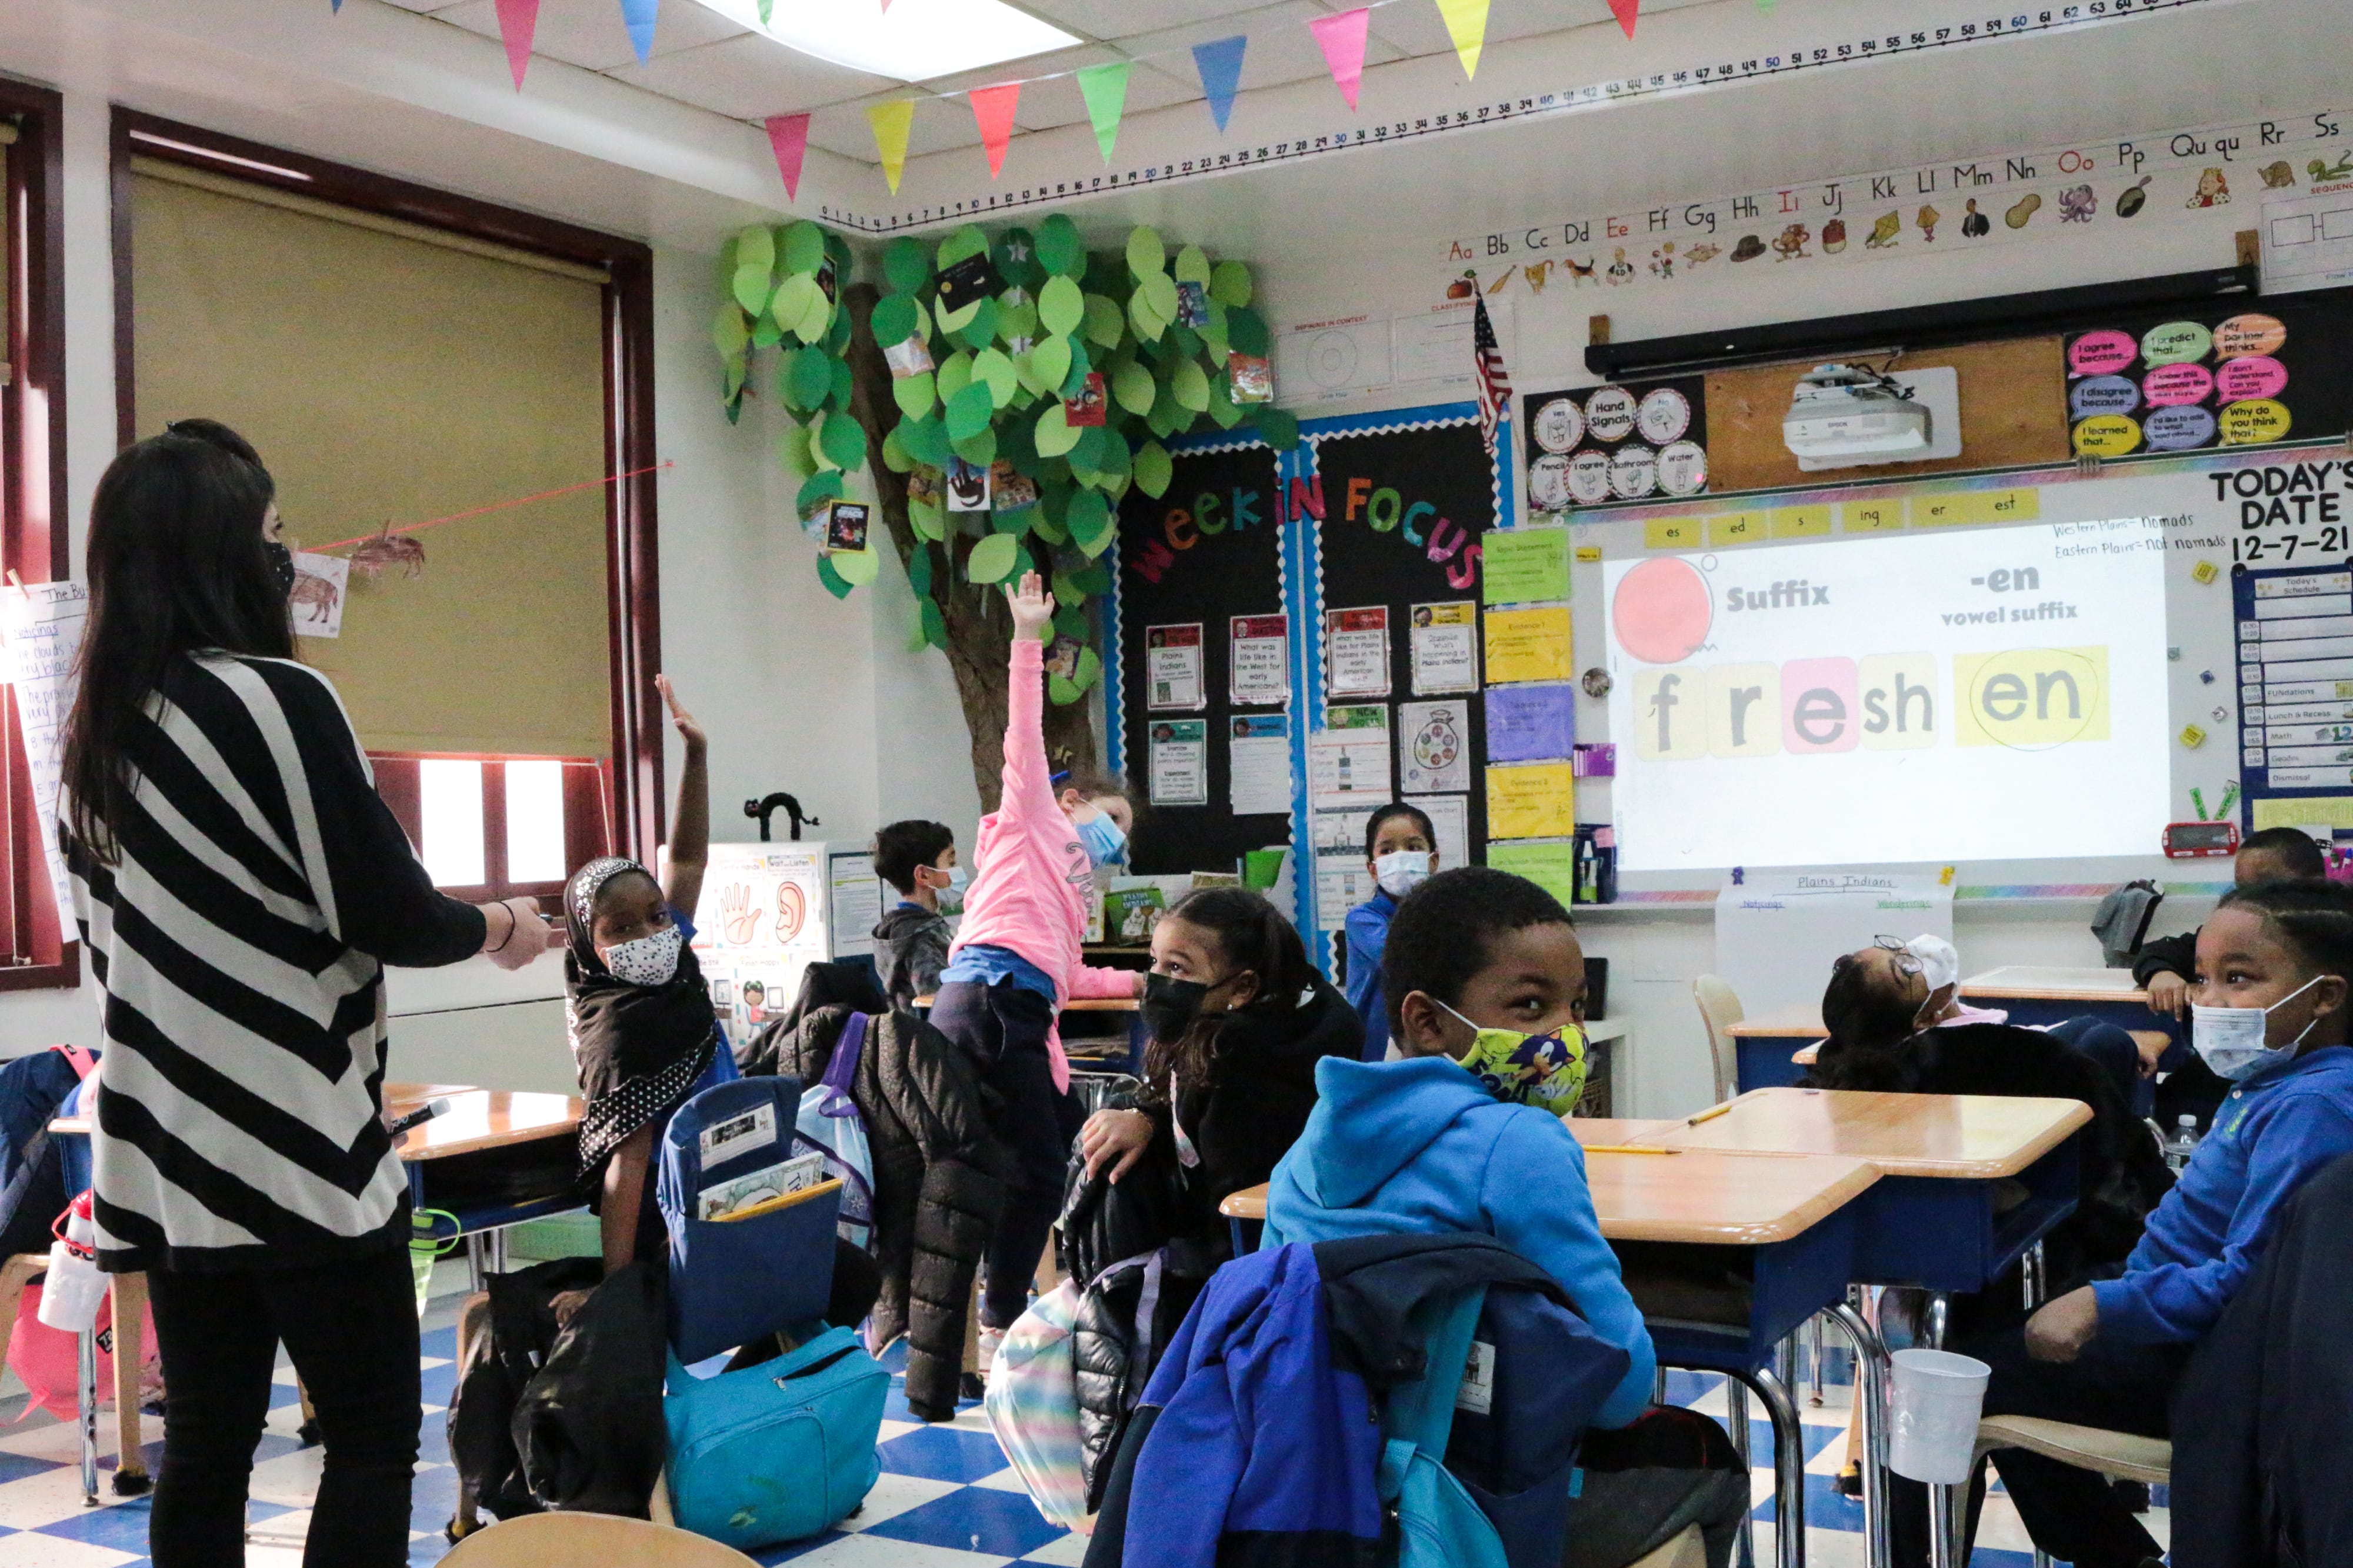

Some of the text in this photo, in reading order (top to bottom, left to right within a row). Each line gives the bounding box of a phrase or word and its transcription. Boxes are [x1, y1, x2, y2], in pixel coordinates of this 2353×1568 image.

[1200, 2, 2105, 168] 23 24 25 26 27 28 29 30 31 32 33 34 35 36 37 38 39 49 50 51 52 53 54 55 56 57 58 59 60 61 62 63
[1449, 113, 2339, 261] Aa Bb Cc Dd Ee Ff Gg Hh Ii Jj Kk Ll Mm Nn Oo Pp Qu qu Rr Ss
[1335, 315, 1368, 325] CONTEXT
[2084, 342, 2115, 353] agree
[2087, 386, 2132, 399] disagree
[1595, 401, 1625, 414] Hand
[2228, 406, 2270, 417] Why do
[1591, 414, 1631, 429] Signals
[2230, 416, 2278, 428] you think
[2088, 425, 2128, 435] learned
[1667, 452, 1695, 463] Water
[1541, 462, 1565, 471] Pencil
[1579, 461, 1605, 471] agree
[1614, 459, 1654, 470] Bathroom
[1931, 505, 1946, 516] er
[1995, 498, 2016, 512] est
[2241, 492, 2340, 530] DATE
[1798, 516, 1804, 527] s
[1859, 508, 1880, 526] ing
[1729, 521, 1746, 535] ed
[2053, 523, 2096, 538] Western
[2141, 513, 2194, 529] nomads
[1666, 526, 1681, 538] es
[2055, 543, 2098, 559] Eastern
[2145, 536, 2168, 551] not
[2175, 535, 2227, 550] nomads
[2233, 525, 2348, 562] 12-7-21
[1970, 566, 2040, 593] -en
[41, 588, 68, 600] The
[1727, 580, 1831, 613] Suffix
[1941, 600, 2079, 628] vowel suffix
[1981, 668, 2082, 721] en
[2268, 712, 2293, 720] Lunch
[2303, 710, 2331, 718] Recess
[2273, 774, 2311, 782] Dismissal
[1798, 875, 1893, 887] Plains Indians
